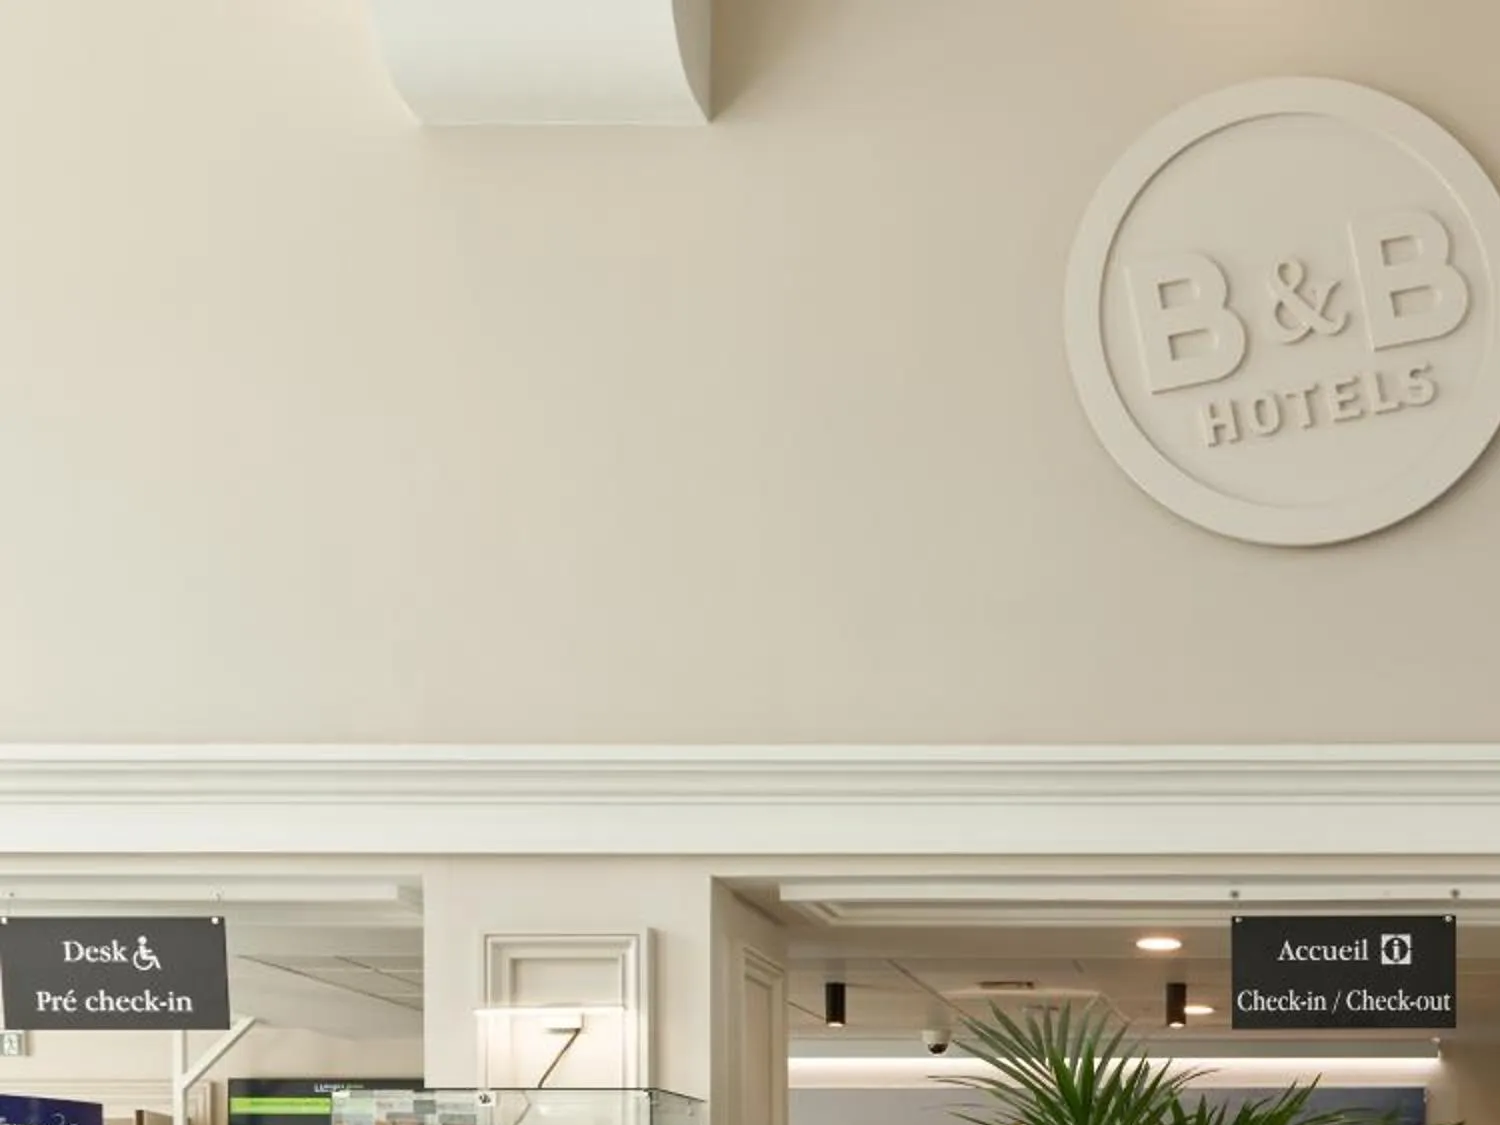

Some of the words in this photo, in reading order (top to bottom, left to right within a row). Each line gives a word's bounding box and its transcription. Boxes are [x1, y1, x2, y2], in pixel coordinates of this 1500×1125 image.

[1125, 209, 1471, 396] B&B
[1200, 361, 1440, 448] HOTELS
[63, 939, 129, 963] Desk
[1277, 938, 1369, 961] Accueil
[36, 989, 77, 1012] Pré
[85, 989, 193, 1012] check-in
[1237, 989, 1327, 1012] Check-in
[1346, 988, 1451, 1012] Check-out
